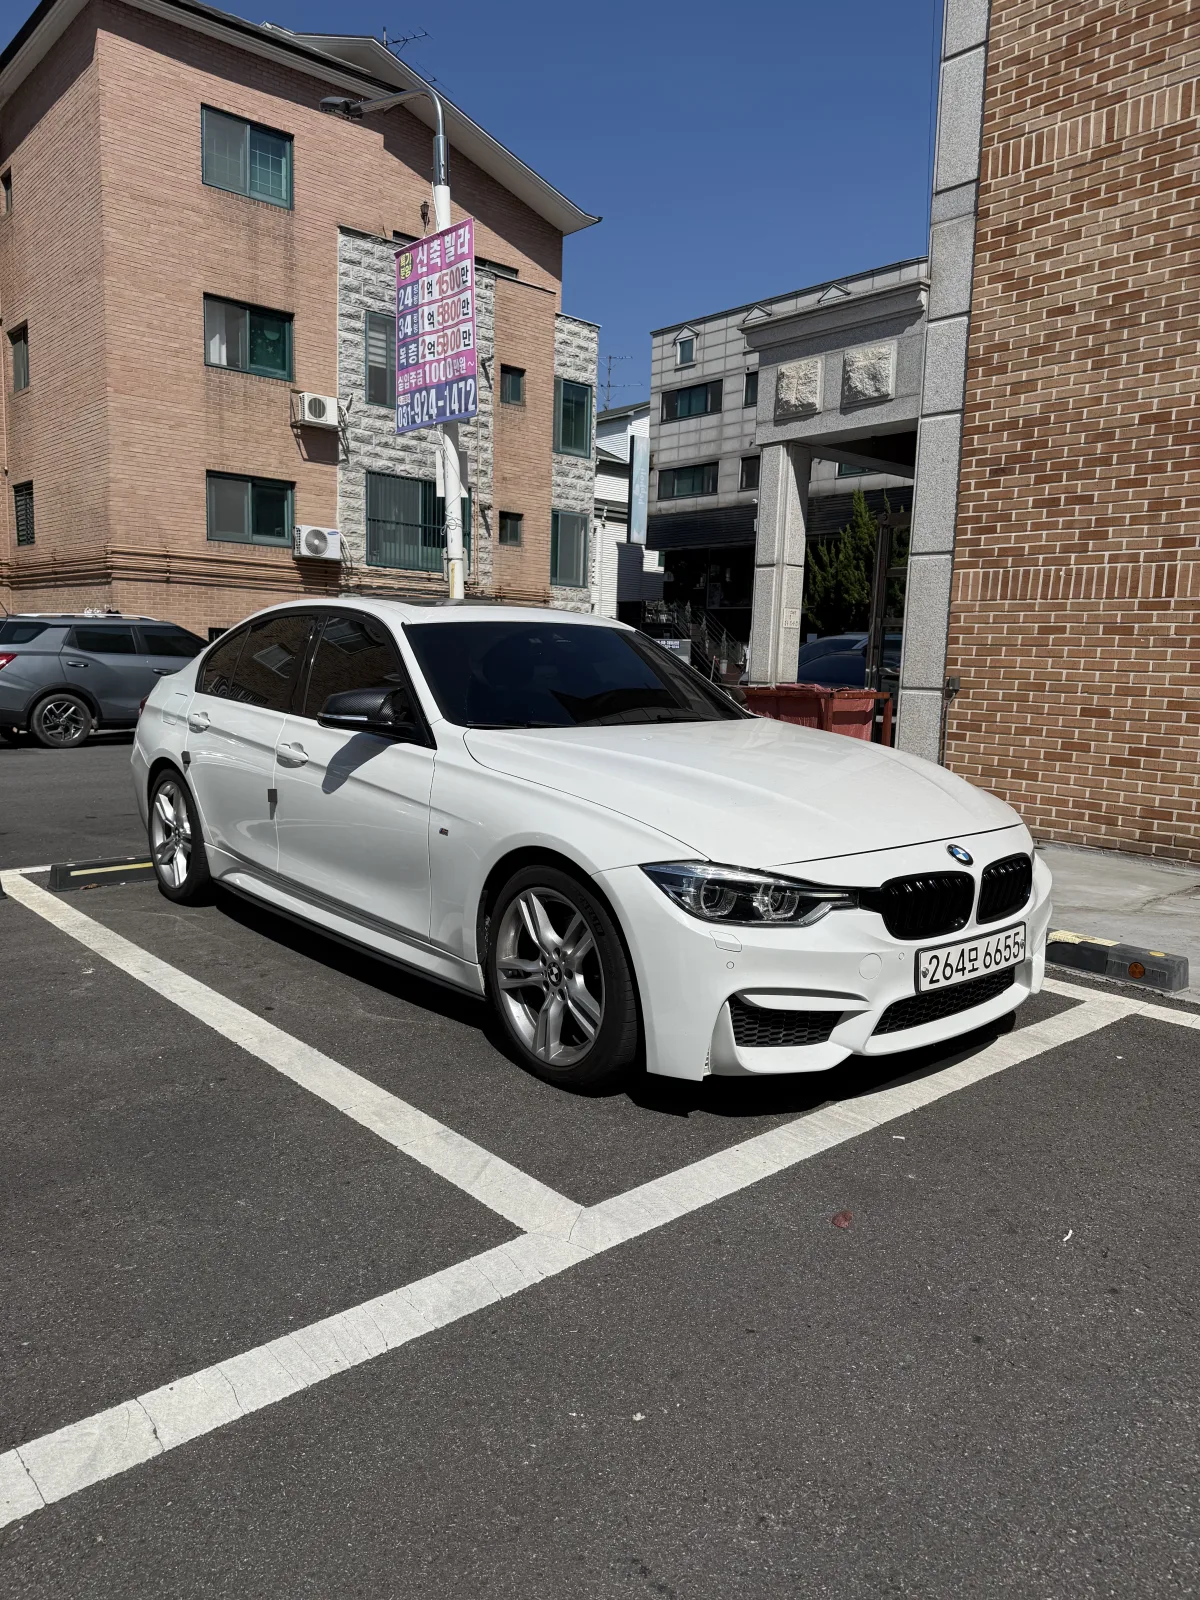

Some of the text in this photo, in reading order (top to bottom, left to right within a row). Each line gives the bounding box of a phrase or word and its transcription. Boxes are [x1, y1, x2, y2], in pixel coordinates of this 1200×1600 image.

[416, 225, 470, 274] 신축빌라
[398, 286, 413, 312] 24
[435, 265, 469, 297] 1500만
[398, 315, 413, 339] 34
[437, 297, 470, 327] 5800만
[399, 343, 418, 366] 복층
[397, 378, 476, 428] 031-924-1472
[398, 368, 423, 392] 실입주금
[928, 931, 1021, 985] 264모 6655
